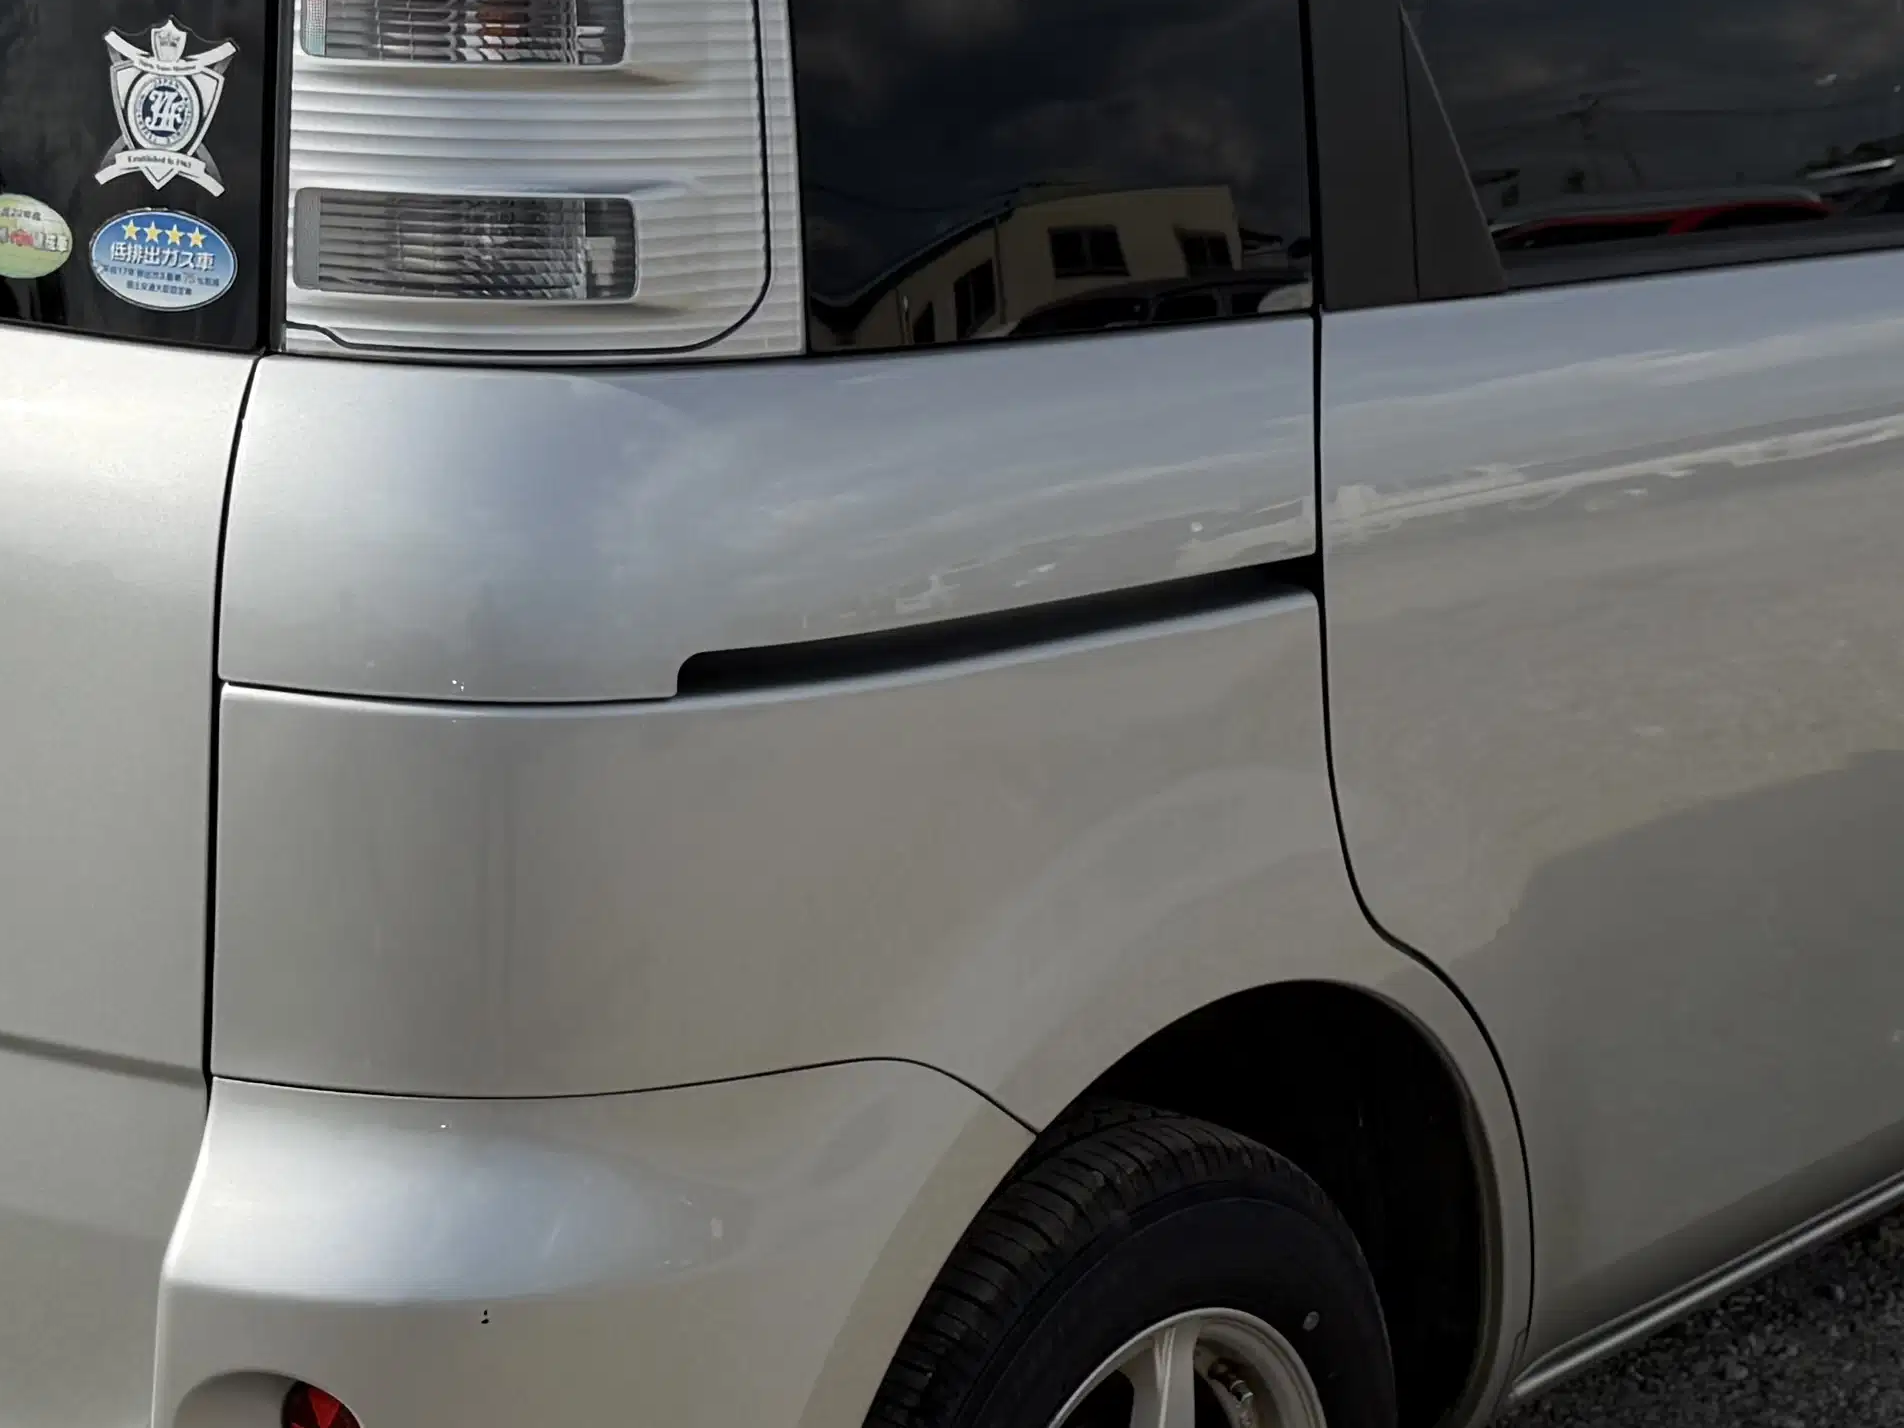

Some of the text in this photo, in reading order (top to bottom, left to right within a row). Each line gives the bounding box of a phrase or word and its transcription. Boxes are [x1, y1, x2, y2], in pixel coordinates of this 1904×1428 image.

[110, 241, 216, 272] 低排出ガス車
